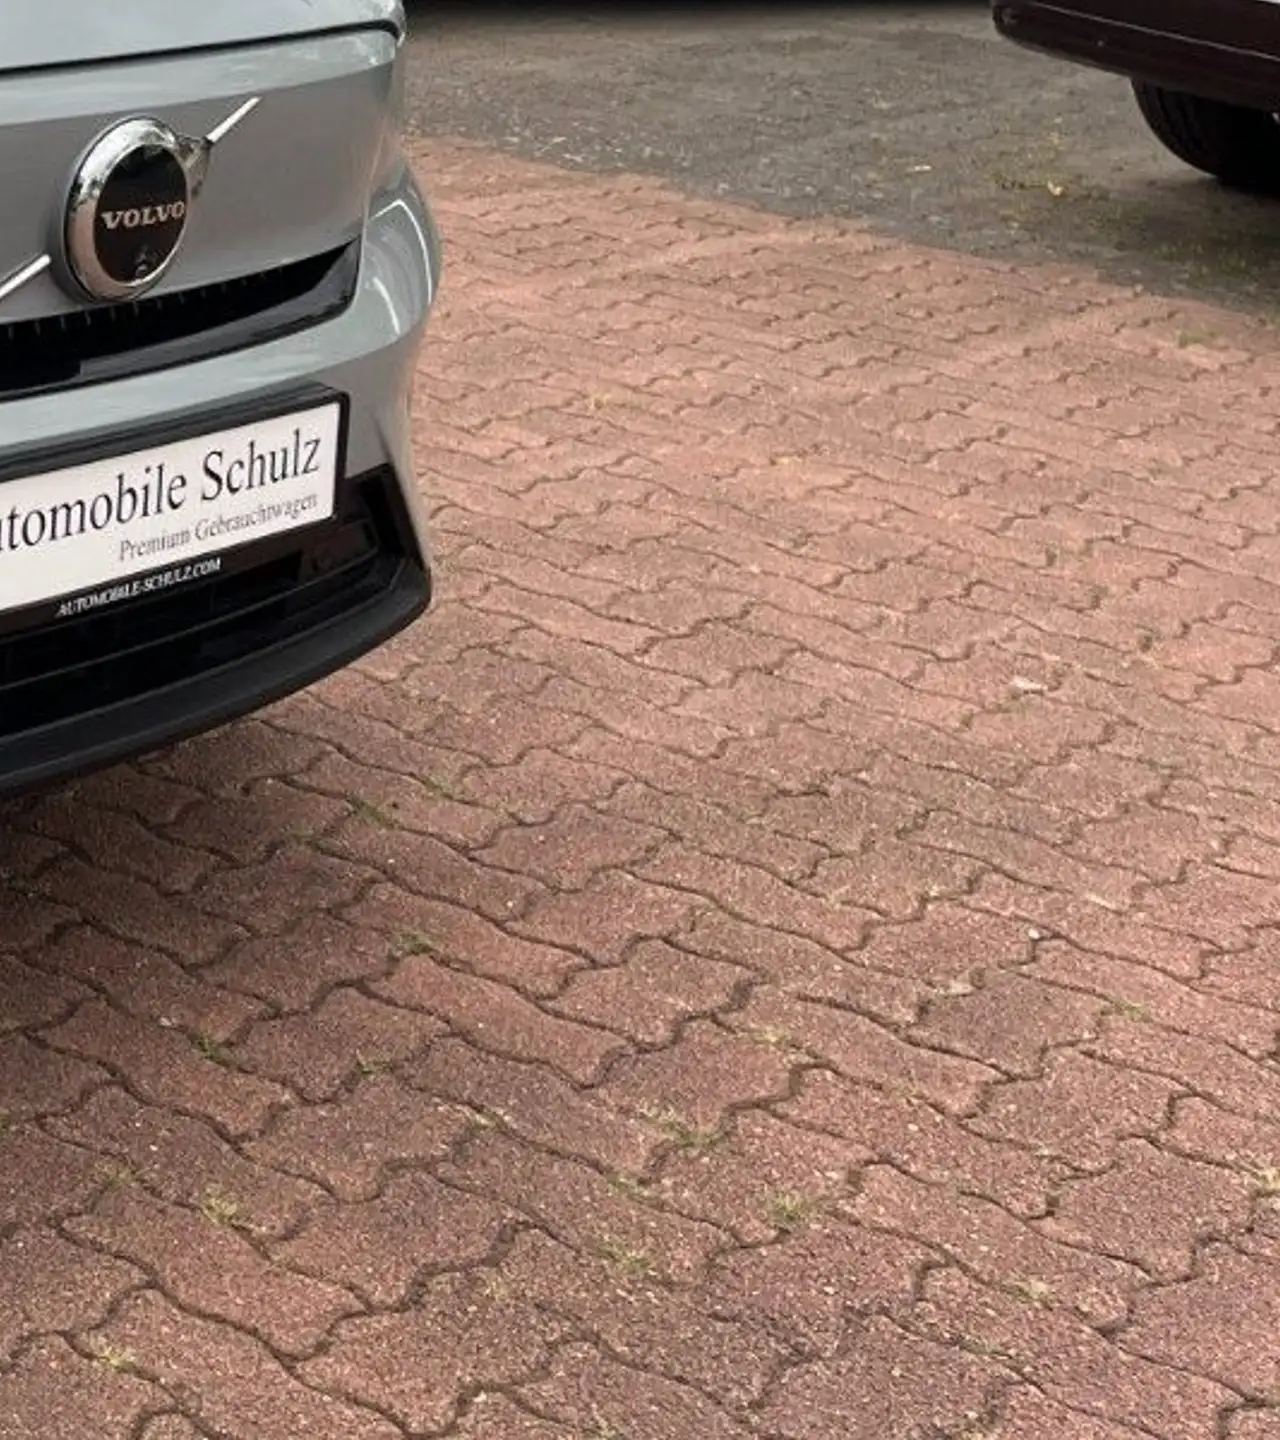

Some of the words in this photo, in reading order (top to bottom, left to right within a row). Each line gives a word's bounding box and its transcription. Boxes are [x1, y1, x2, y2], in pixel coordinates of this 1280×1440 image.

[100, 201, 186, 229] VOLVO
[200, 428, 322, 501] Schulz
[119, 528, 190, 561] Premium
[194, 493, 319, 541] Gebrauchtwagen
[54, 557, 222, 619] AUTOMOBILE-SCHULZ.COM
